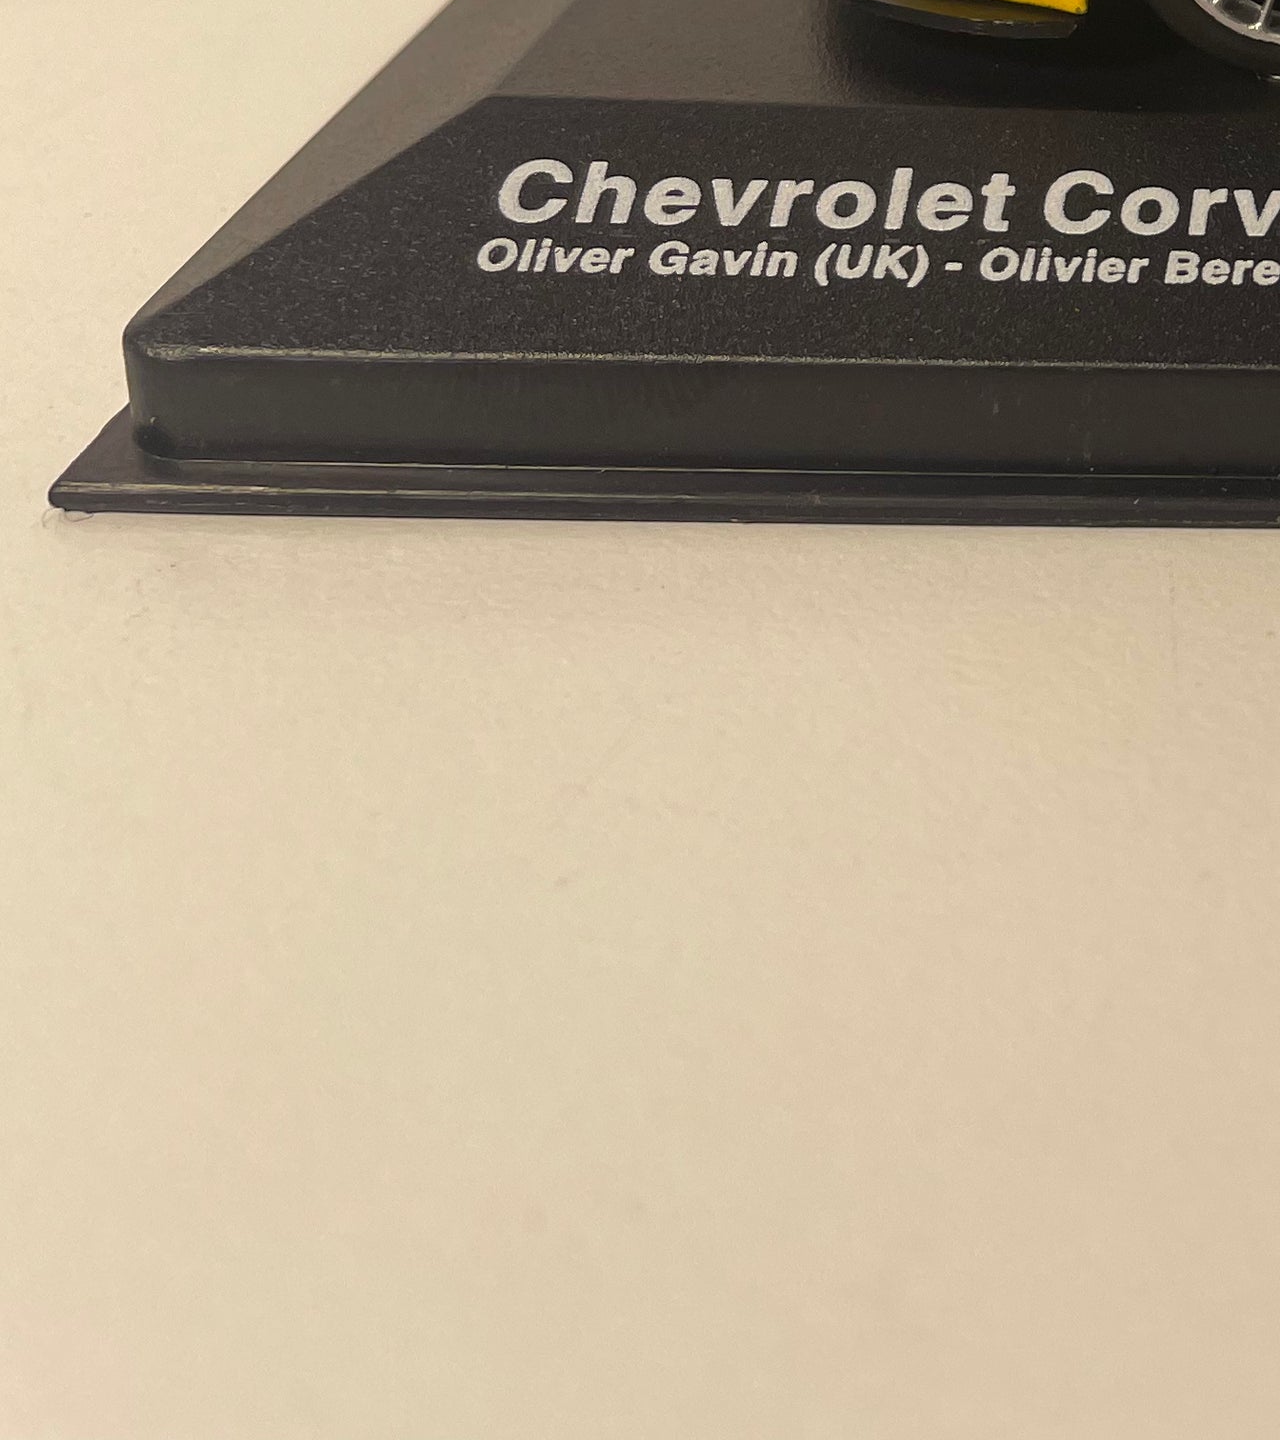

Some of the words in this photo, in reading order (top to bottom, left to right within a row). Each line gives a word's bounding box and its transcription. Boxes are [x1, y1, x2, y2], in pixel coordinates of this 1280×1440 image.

[498, 158, 1017, 232] Chevrolet
[477, 237, 635, 274] Oliver
[648, 240, 799, 277] Gavin
[814, 243, 930, 288] (UK)
[979, 246, 1149, 284] Olivier
